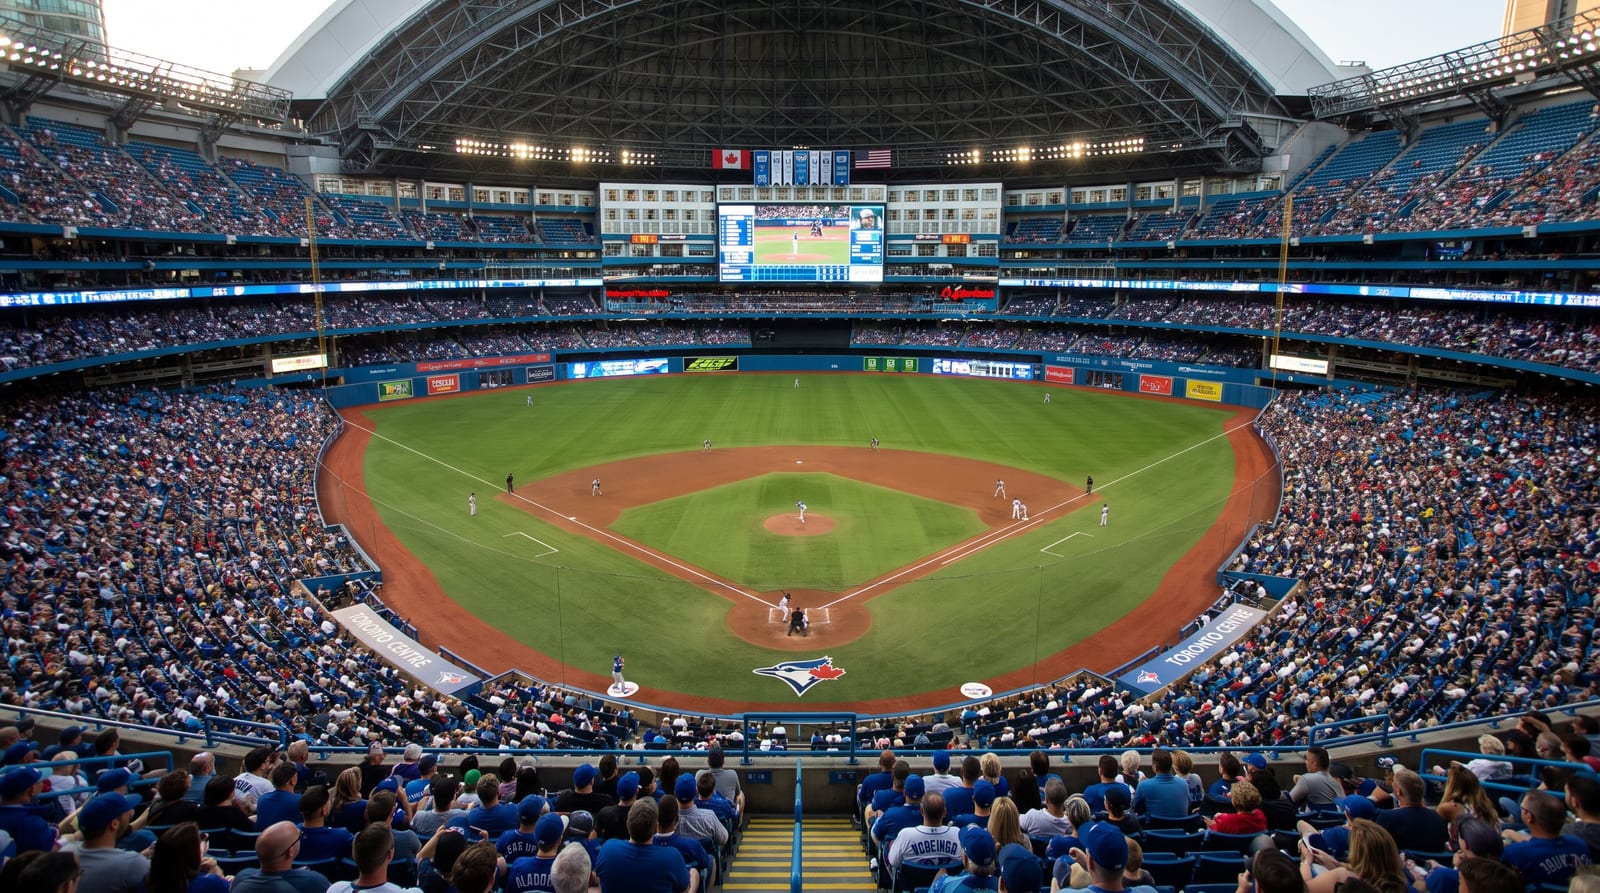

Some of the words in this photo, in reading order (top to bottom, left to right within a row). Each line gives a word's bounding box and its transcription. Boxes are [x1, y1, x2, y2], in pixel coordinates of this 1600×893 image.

[349, 612, 394, 643] TORONTO
[386, 641, 433, 669] CENTRE
[1165, 631, 1224, 666] TORONTO
[1215, 608, 1255, 633] CENTRE
